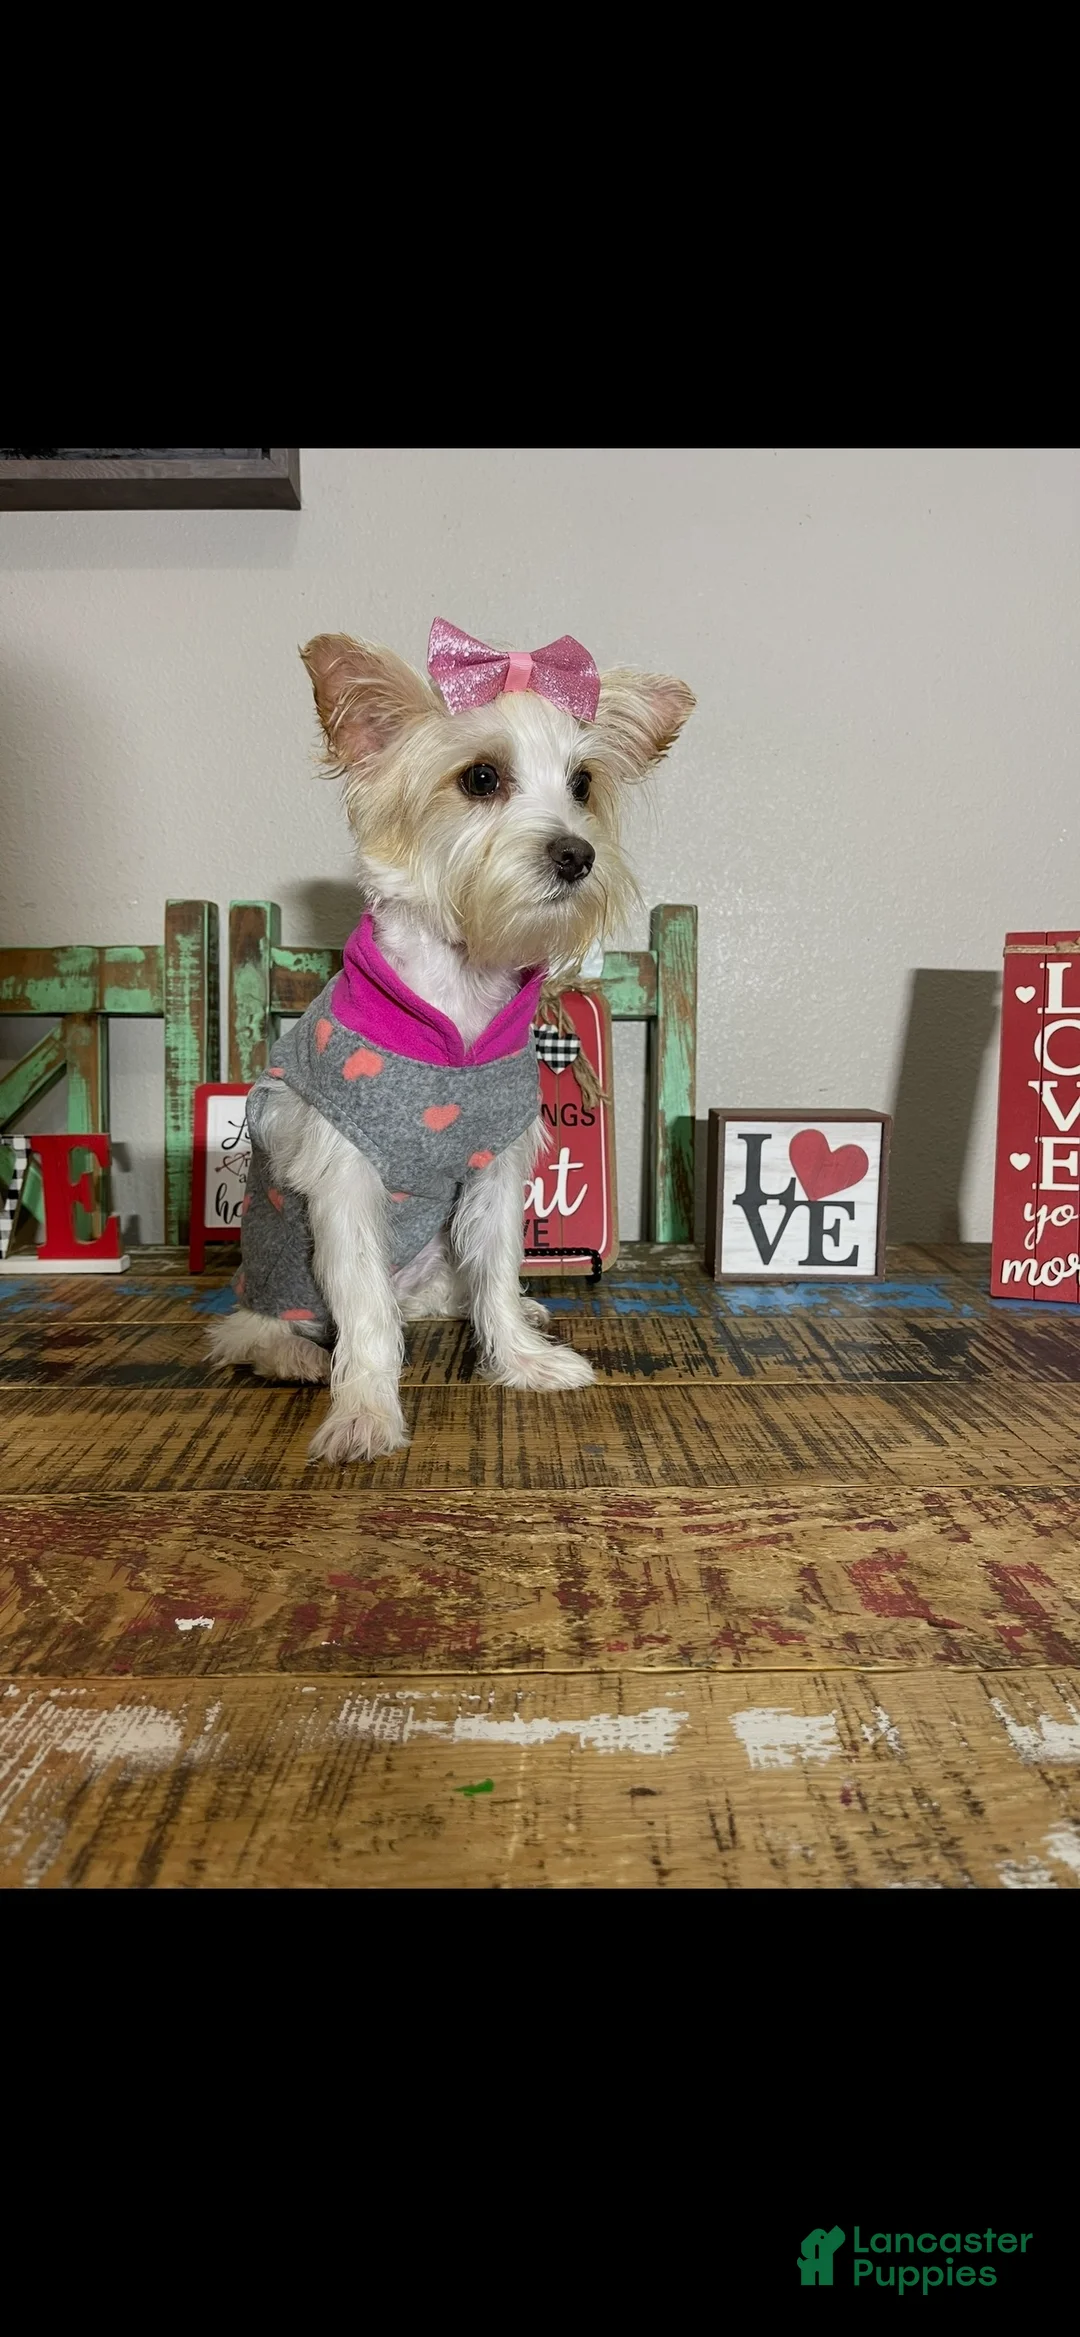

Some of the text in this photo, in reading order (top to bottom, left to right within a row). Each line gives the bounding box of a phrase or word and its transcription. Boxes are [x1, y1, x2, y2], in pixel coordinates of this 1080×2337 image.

[541, 1103, 596, 1127] NGS
[523, 1147, 588, 1218] at
[1023, 1202, 1079, 1251] yo
